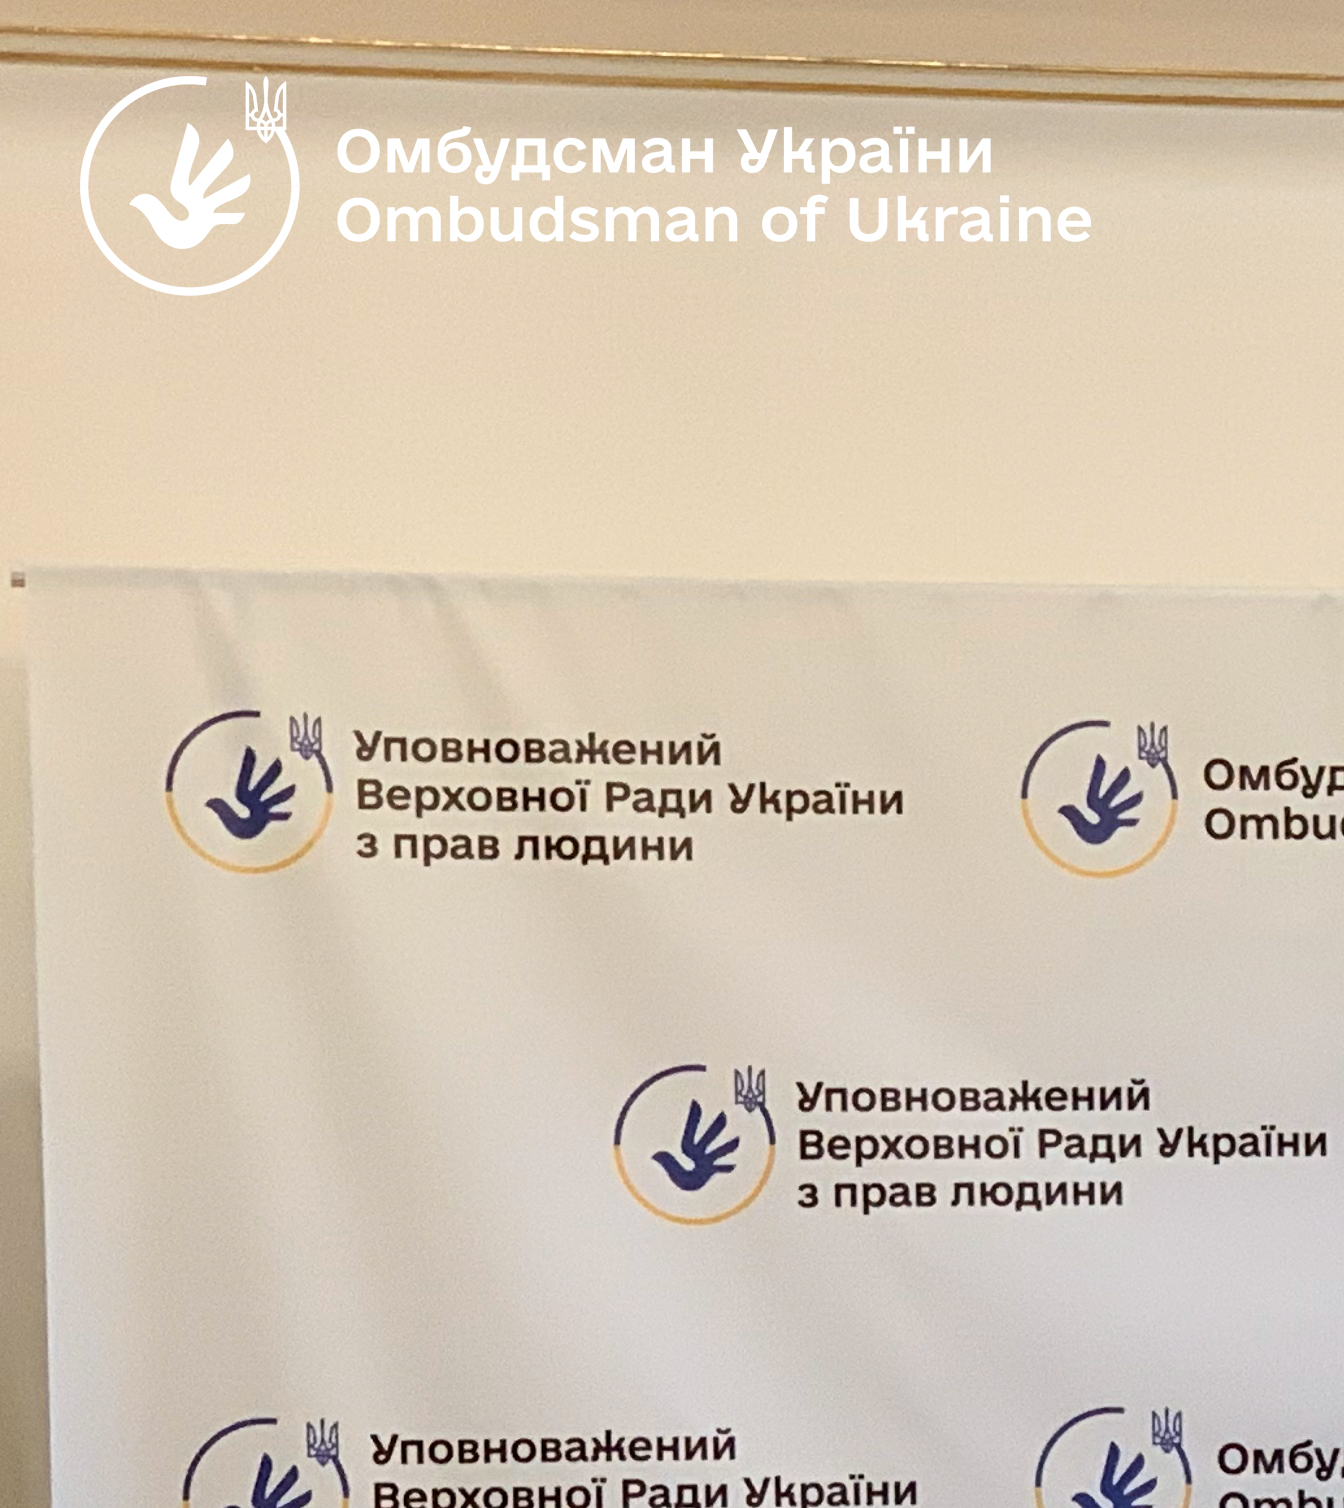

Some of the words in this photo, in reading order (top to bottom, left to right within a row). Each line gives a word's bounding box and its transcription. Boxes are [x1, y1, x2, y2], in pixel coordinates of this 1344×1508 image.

[353, 730, 721, 766] Уповноважений
[357, 778, 591, 819] Верховної
[605, 781, 712, 819] Ради
[727, 781, 903, 822] України
[356, 832, 379, 859] з
[394, 833, 500, 867] прав
[514, 834, 693, 866] людини
[795, 1078, 1150, 1113] Уповноважений
[799, 1126, 1024, 1168] Верховної
[1038, 1128, 1142, 1164] Ради
[1156, 1124, 1327, 1165] України
[797, 1183, 819, 1209] з
[834, 1182, 937, 1216] прав
[950, 1181, 1123, 1212] людини
[370, 1427, 736, 1466] Уповноважений
